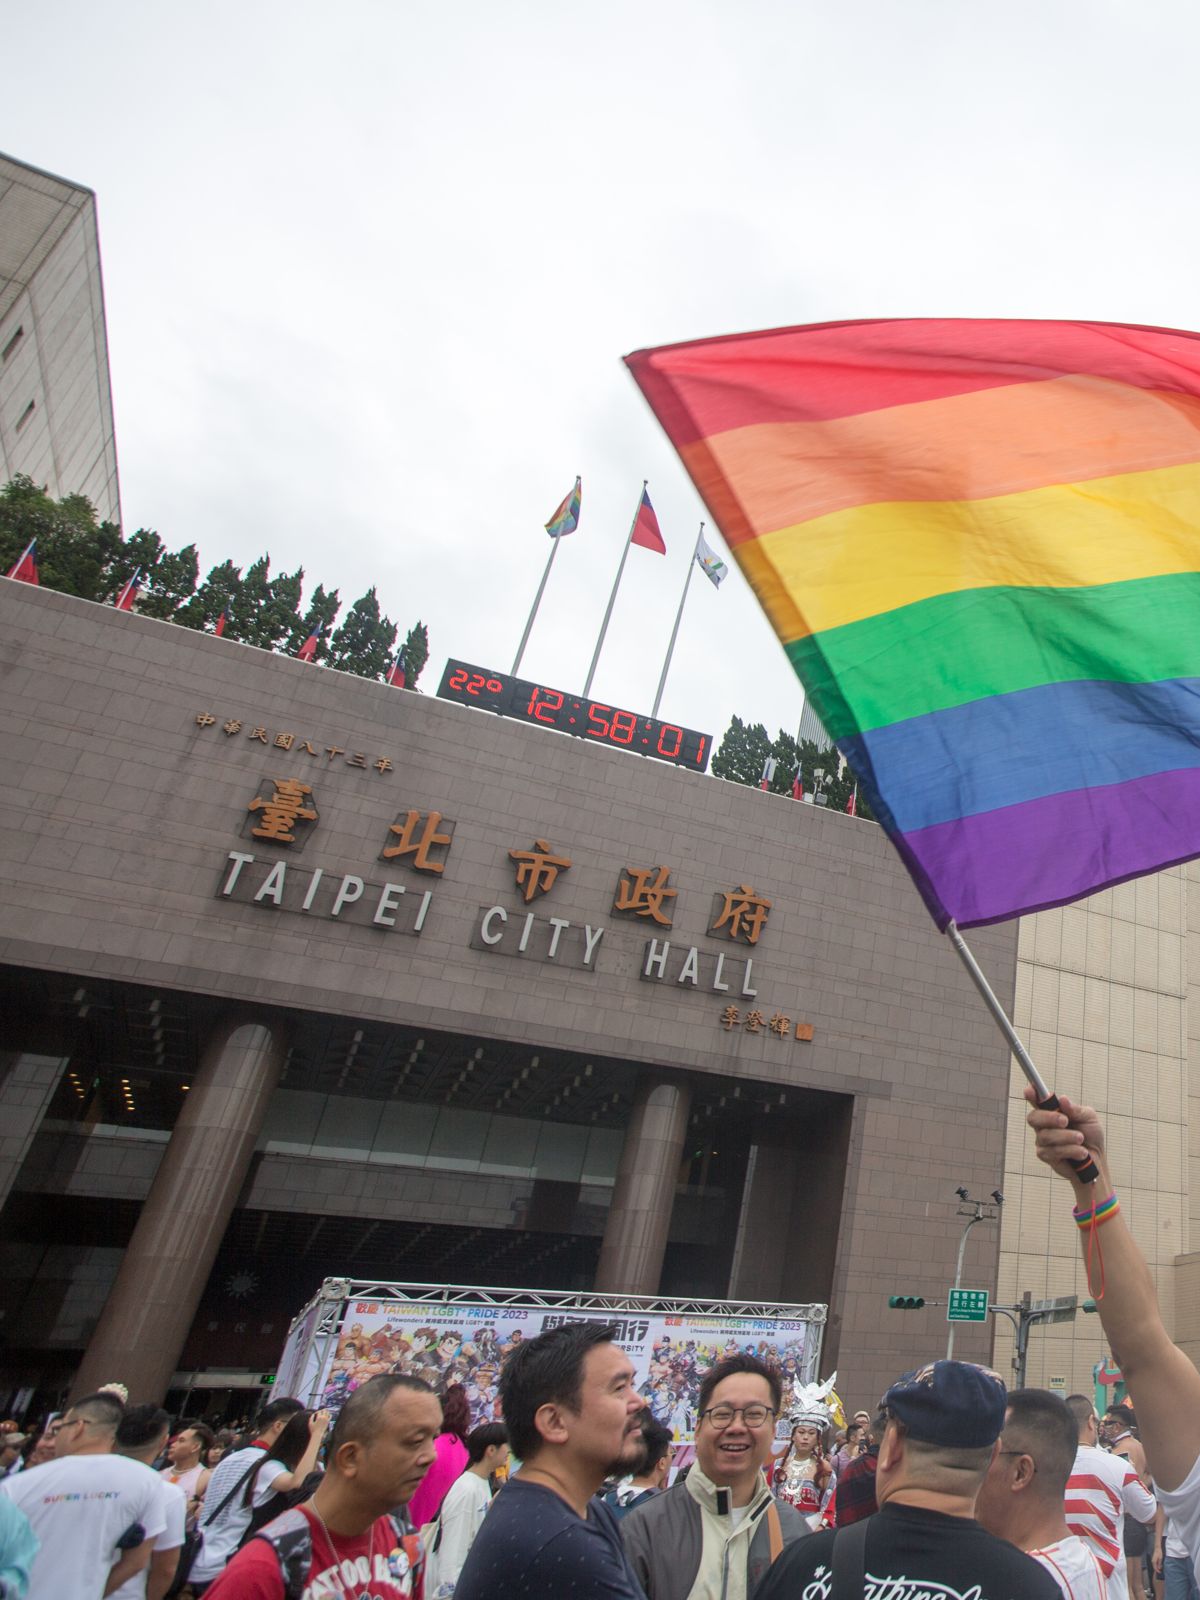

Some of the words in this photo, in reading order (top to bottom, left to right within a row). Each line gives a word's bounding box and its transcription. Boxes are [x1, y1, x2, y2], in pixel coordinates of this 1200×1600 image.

[196, 712, 394, 774] 中華民國八十三年
[527, 686, 706, 765] 12:58:01
[247, 777, 773, 945] 臺北市政府
[222, 850, 433, 932] TAIPEI
[480, 905, 605, 965] CITY
[644, 937, 758, 997] HALL
[382, 1304, 430, 1317] TAIWAN
[467, 1308, 500, 1320] PRIDE
[500, 1309, 529, 1320] 2023
[685, 1317, 724, 1328] TAIWAN
[752, 1319, 778, 1331] PRIDE
[779, 1321, 801, 1332] 2023
[44, 1492, 81, 1504] SUPER
[83, 1490, 121, 1500] LUCKY
